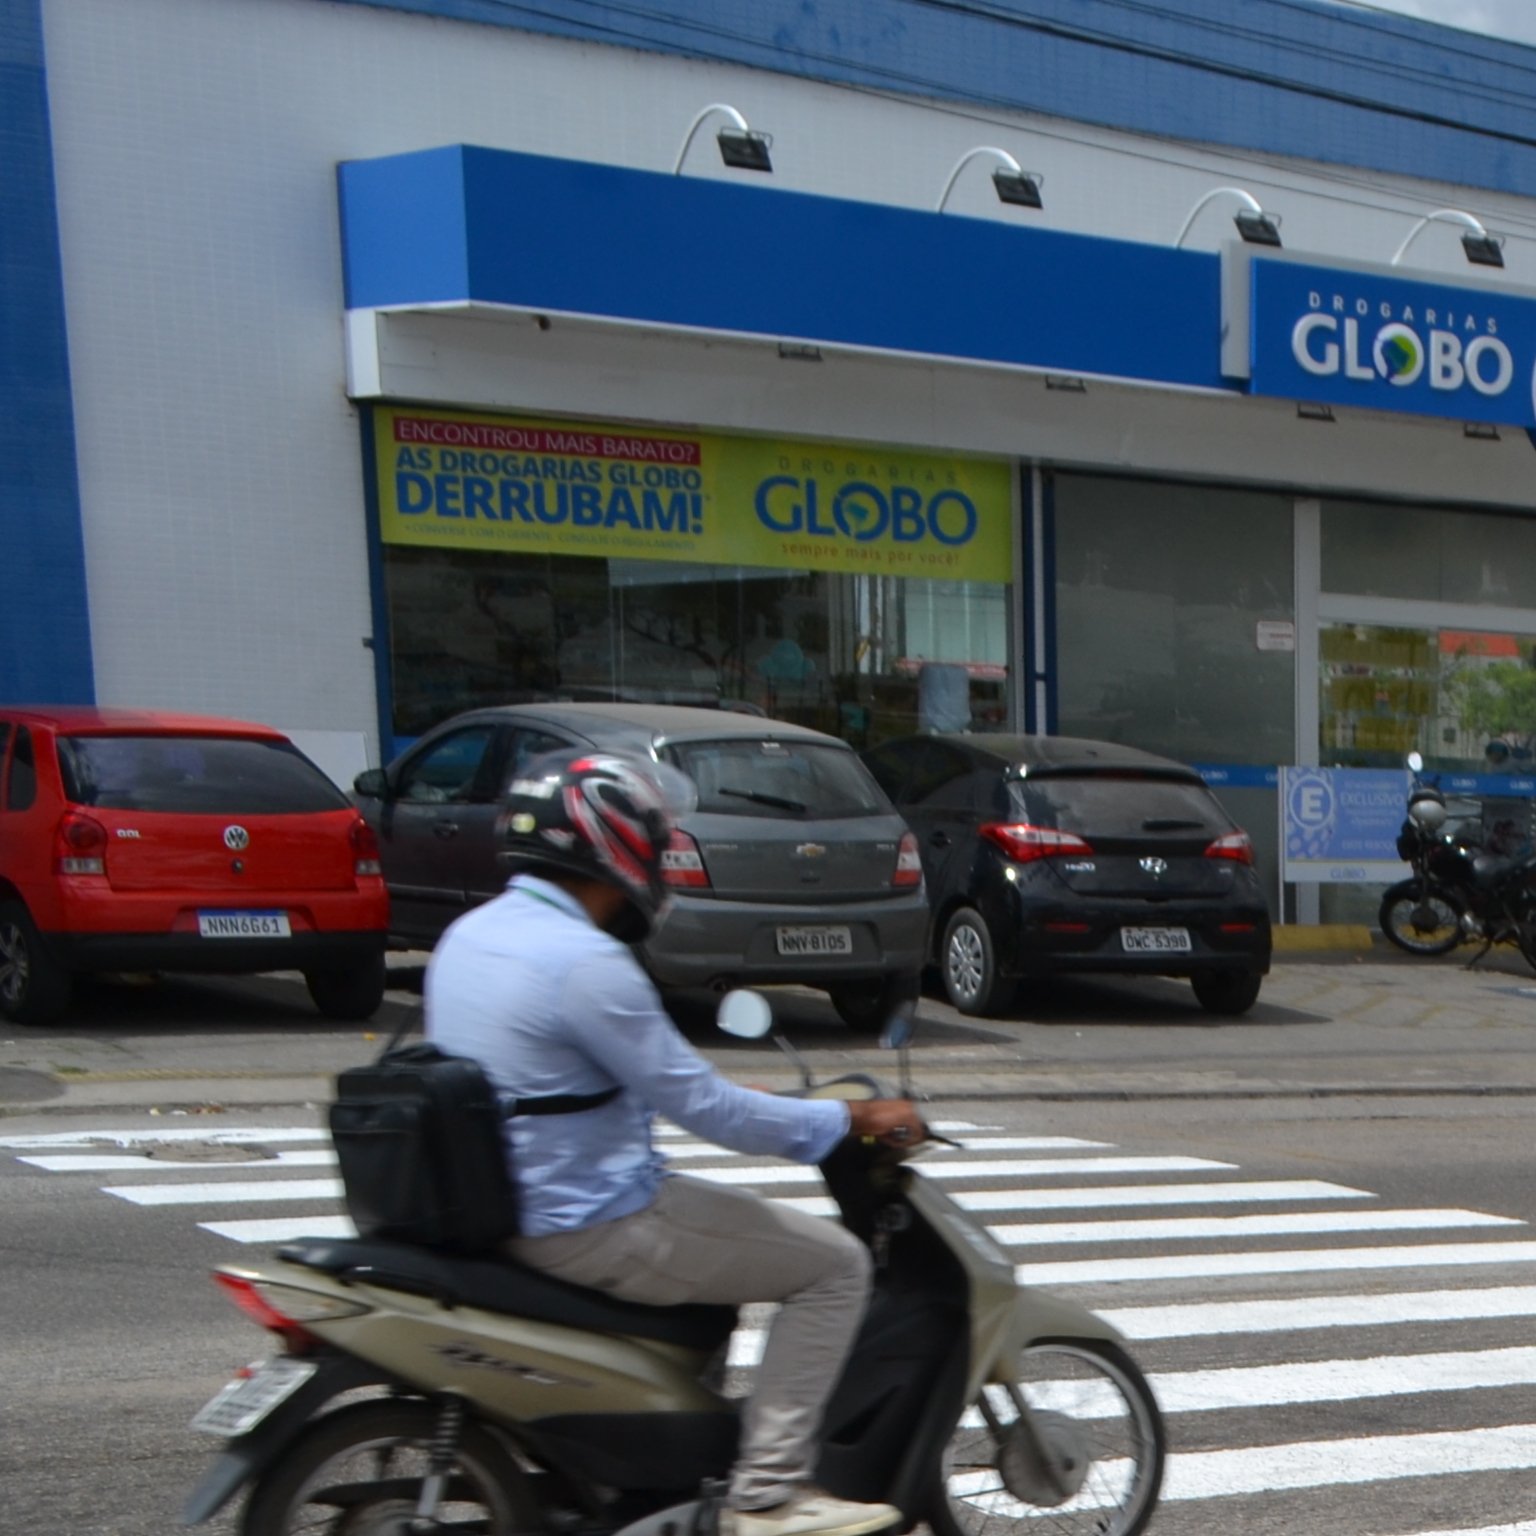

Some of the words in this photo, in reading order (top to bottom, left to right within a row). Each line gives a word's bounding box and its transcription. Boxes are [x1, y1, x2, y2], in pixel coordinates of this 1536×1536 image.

[1308, 291, 1498, 334] DROGARIAS
[1291, 311, 1514, 396] GLOBO
[399, 420, 540, 450] ENCONTROU
[546, 431, 598, 455] MAIS
[603, 437, 695, 463] BARATO?
[396, 446, 432, 470] AS
[440, 450, 603, 484] DROGARIAS
[608, 461, 703, 491] GLOBO
[778, 456, 957, 485] DROGARIAS
[395, 471, 705, 535] DERRUBAM!
[754, 474, 978, 546] GLOBO
[782, 542, 839, 558] sempre
[845, 546, 881, 560] mais
[888, 550, 912, 564] por
[919, 552, 960, 566] você!
[1301, 787, 1324, 820] E
[1340, 792, 1404, 806] EXCLUSIVO
[208, 918, 282, 934] NNN6G61
